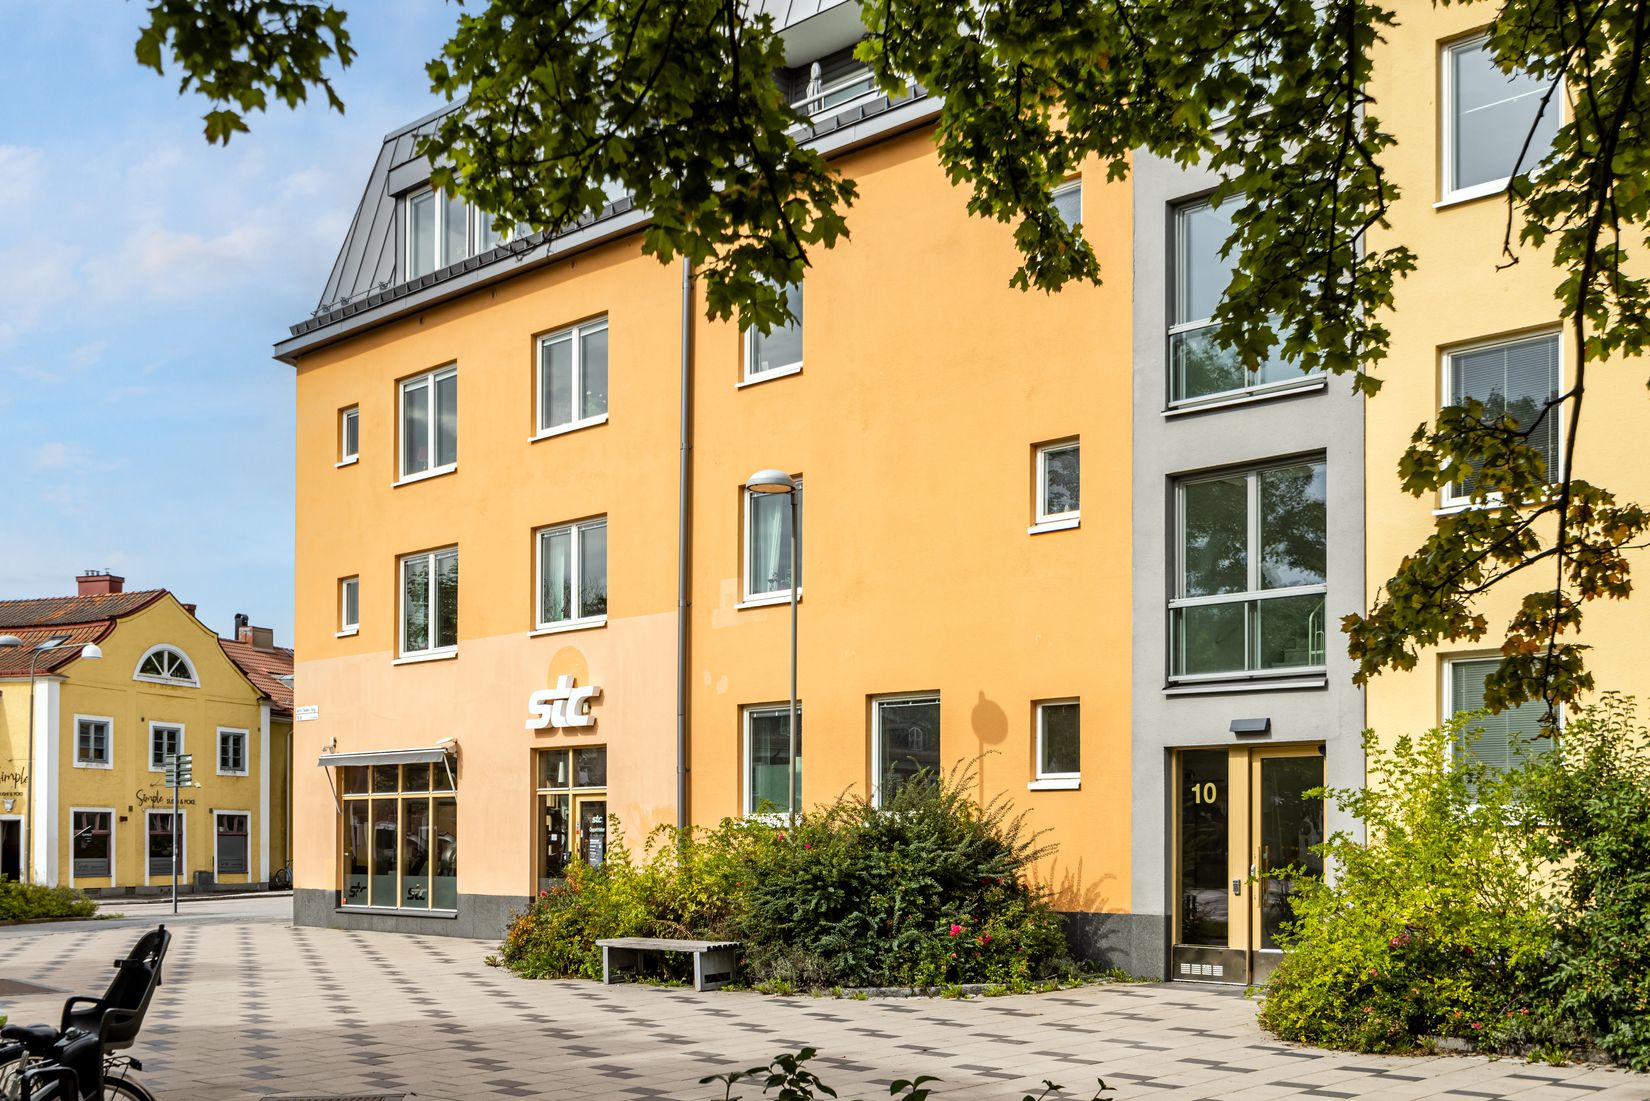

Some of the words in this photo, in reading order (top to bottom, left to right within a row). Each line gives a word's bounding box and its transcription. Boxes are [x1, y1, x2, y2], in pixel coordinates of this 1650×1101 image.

[525, 675, 600, 729] stc
[0, 766, 28, 789] imple
[135, 789, 163, 808] Simple
[1191, 782, 1217, 804] 10
[591, 814, 603, 824] stc
